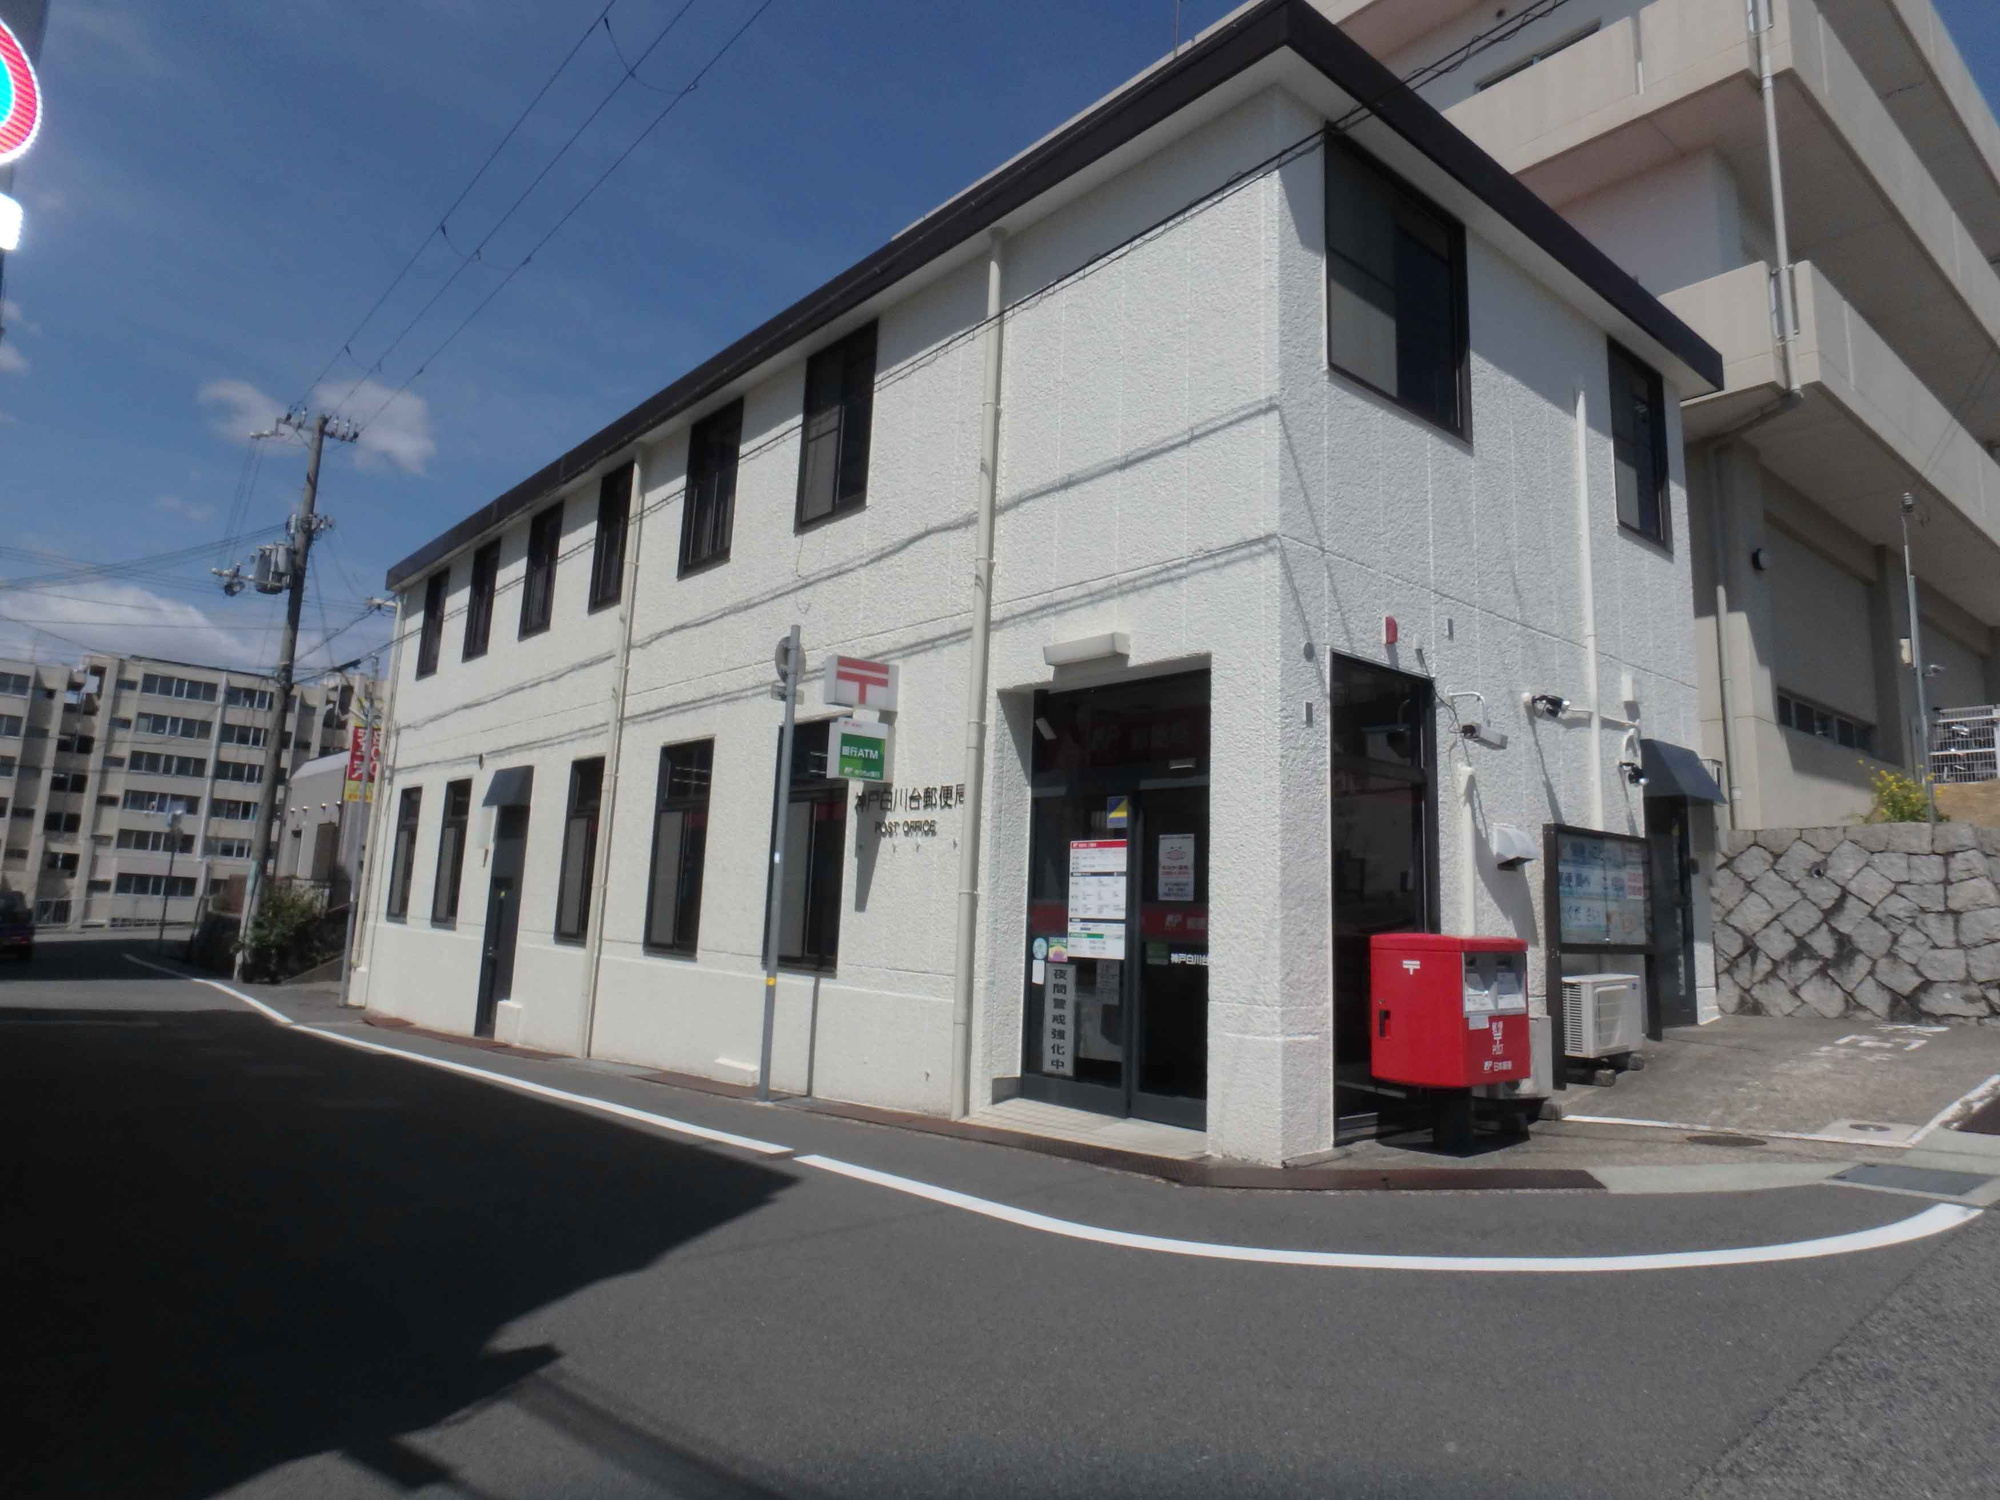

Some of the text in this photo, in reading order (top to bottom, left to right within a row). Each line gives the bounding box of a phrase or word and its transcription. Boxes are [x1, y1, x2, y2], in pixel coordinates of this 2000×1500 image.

[842, 745, 878, 759] 銀行ATM
[875, 820, 937, 835] POST OFFICE
[1051, 968, 1067, 1070] 夜間警戒強化中
